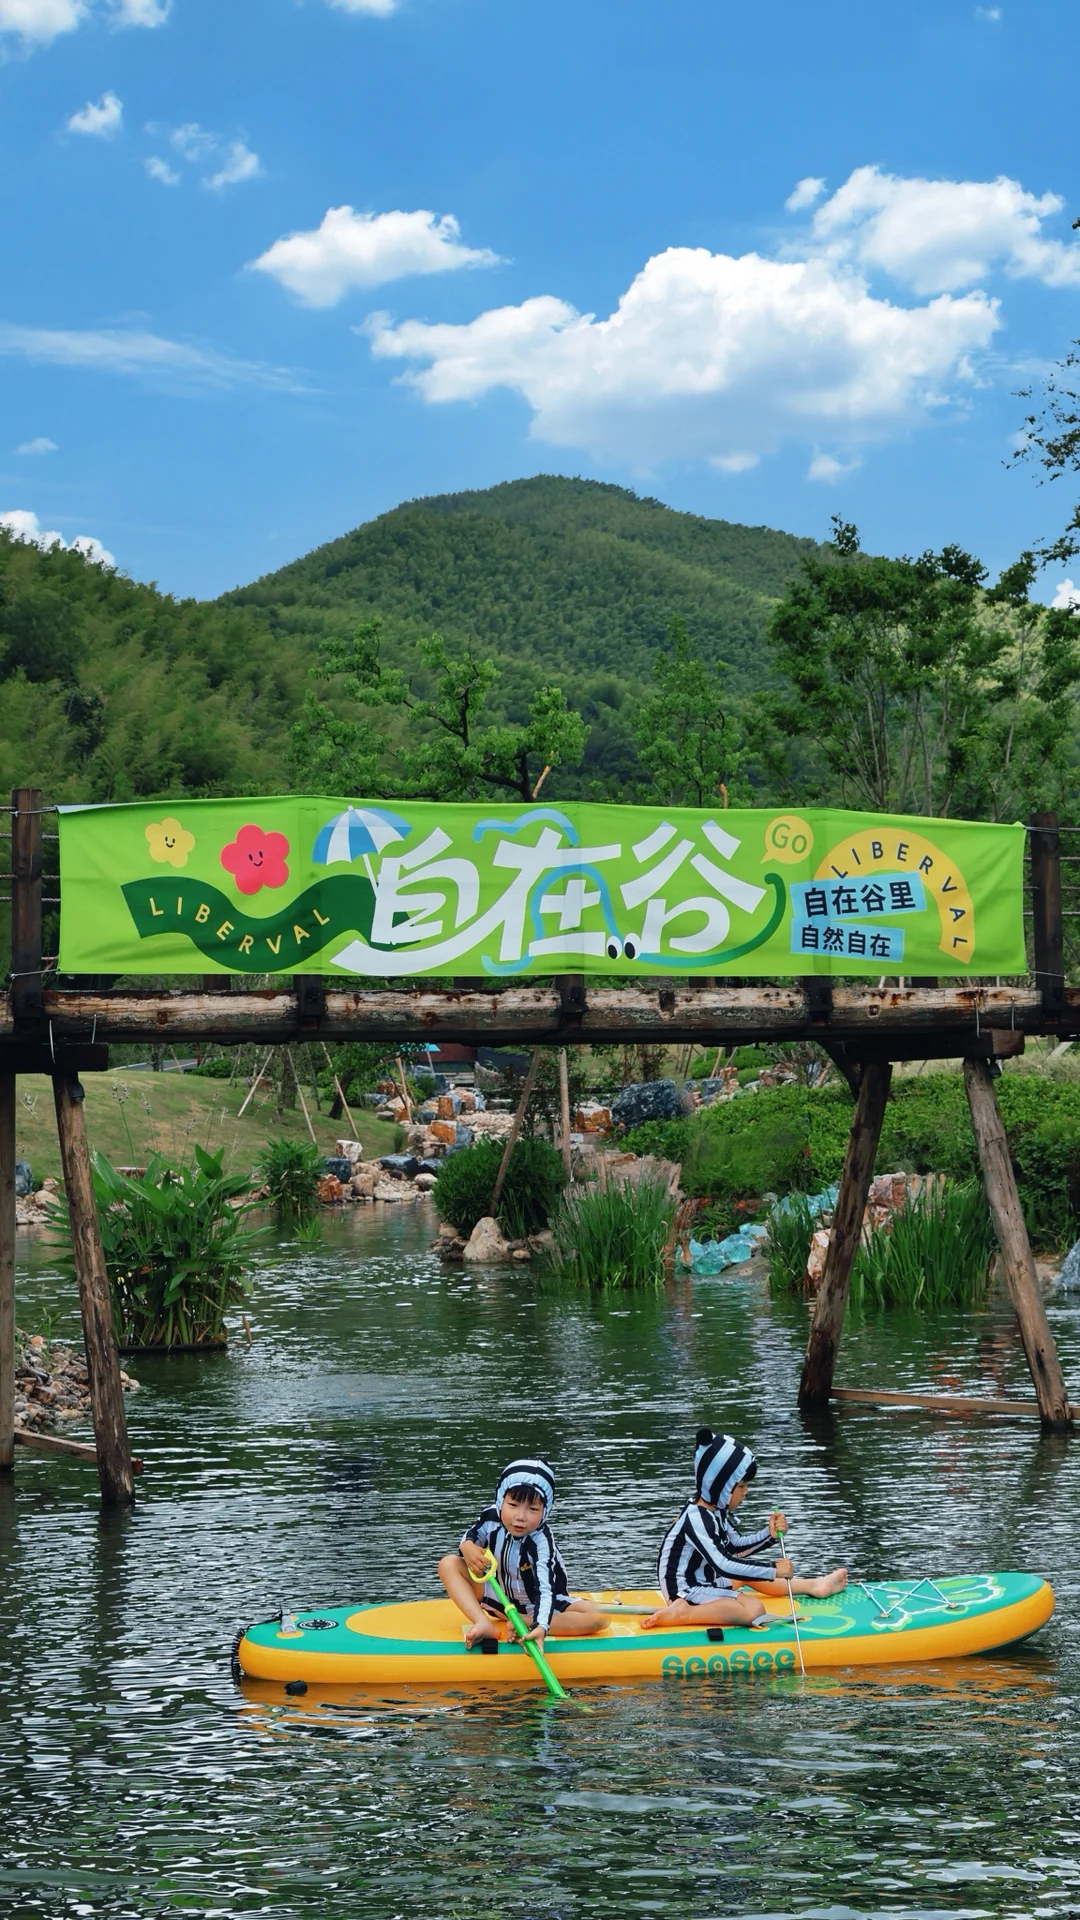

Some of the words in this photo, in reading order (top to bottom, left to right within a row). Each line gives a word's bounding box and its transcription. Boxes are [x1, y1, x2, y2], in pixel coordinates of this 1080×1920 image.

[329, 820, 767, 976] 自在谷
[804, 880, 917, 919] 自在谷里
[831, 841, 968, 949] LIBERVAL
[149, 896, 330, 955] LIBERVAL
[801, 924, 891, 958] 自然自在
